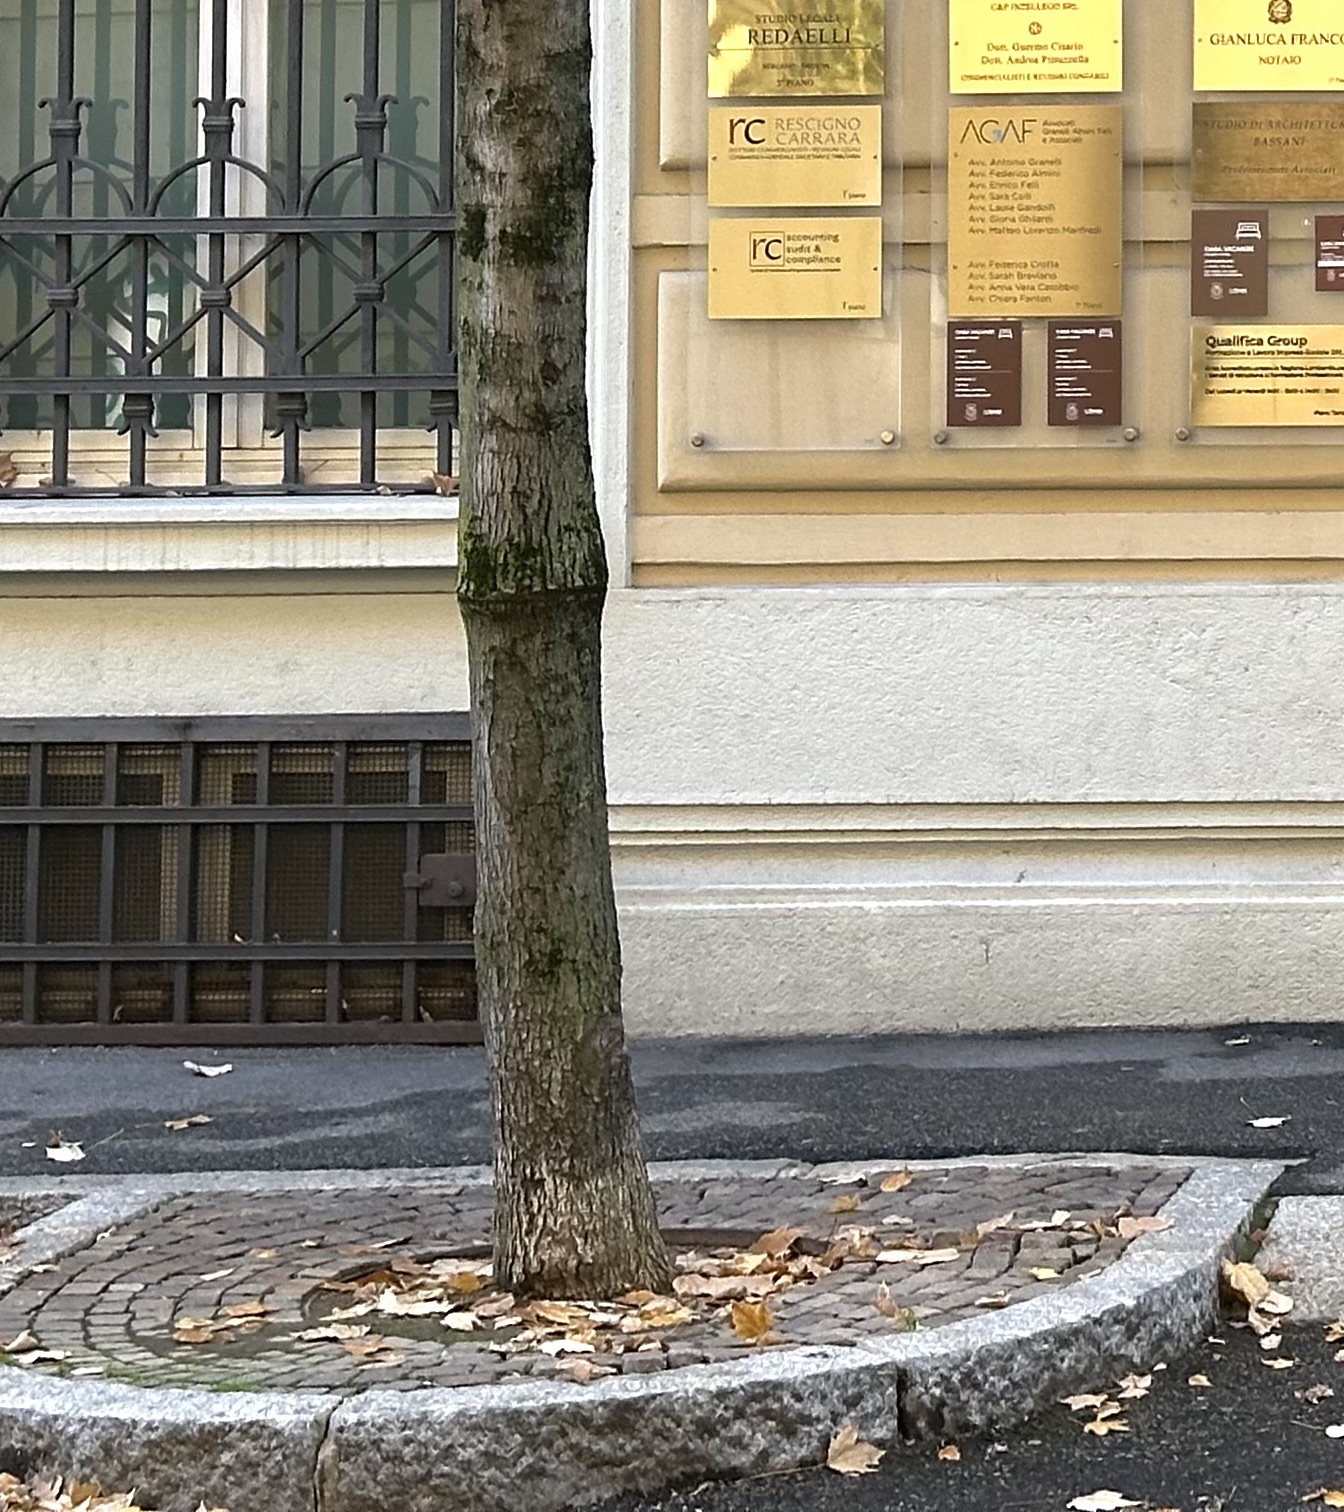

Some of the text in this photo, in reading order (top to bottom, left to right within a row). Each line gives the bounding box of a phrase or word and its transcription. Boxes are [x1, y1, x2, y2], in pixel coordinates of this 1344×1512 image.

[755, 14, 797, 24] STUDIO
[748, 28, 851, 46] REDAELLI
[1209, 33, 1287, 46] GIANLUCA
[1258, 55, 1302, 65] NOTAIO
[775, 117, 862, 131] RESCIGNO
[1203, 119, 1247, 130] STUDIO
[1250, 119, 1263, 130] DI
[728, 117, 766, 145] rc
[960, 119, 1038, 144] AGAF
[775, 131, 862, 146] CARRARA
[989, 169, 1029, 177] Federico
[786, 233, 840, 243] accounting
[753, 238, 782, 260] rc
[786, 244, 822, 253] audit &
[786, 254, 841, 265] compliance
[1205, 335, 1308, 348] Qualifica Group
